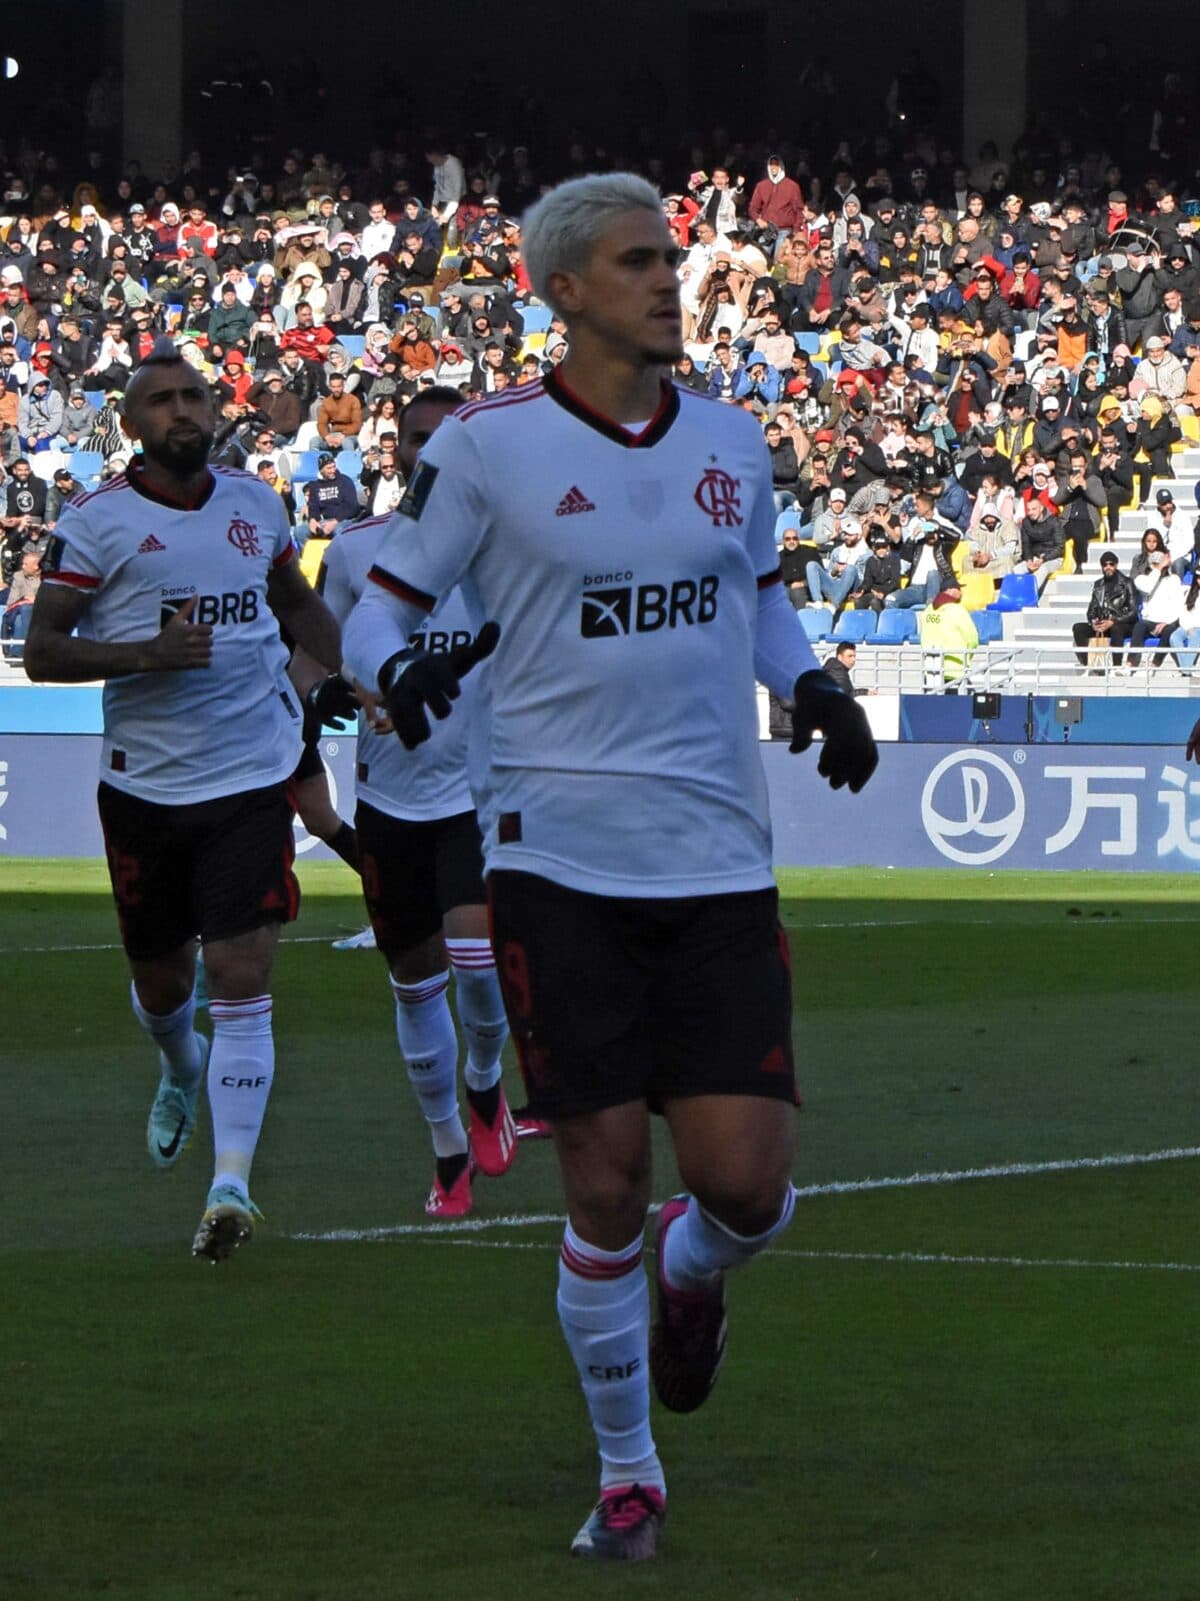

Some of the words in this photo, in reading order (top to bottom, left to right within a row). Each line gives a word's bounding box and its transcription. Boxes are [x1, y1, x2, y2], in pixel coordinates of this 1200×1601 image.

[555, 502, 596, 517] adidas
[582, 570, 634, 586] banco
[161, 585, 197, 597] banco
[198, 589, 259, 626] BRB
[635, 574, 720, 633] BRB
